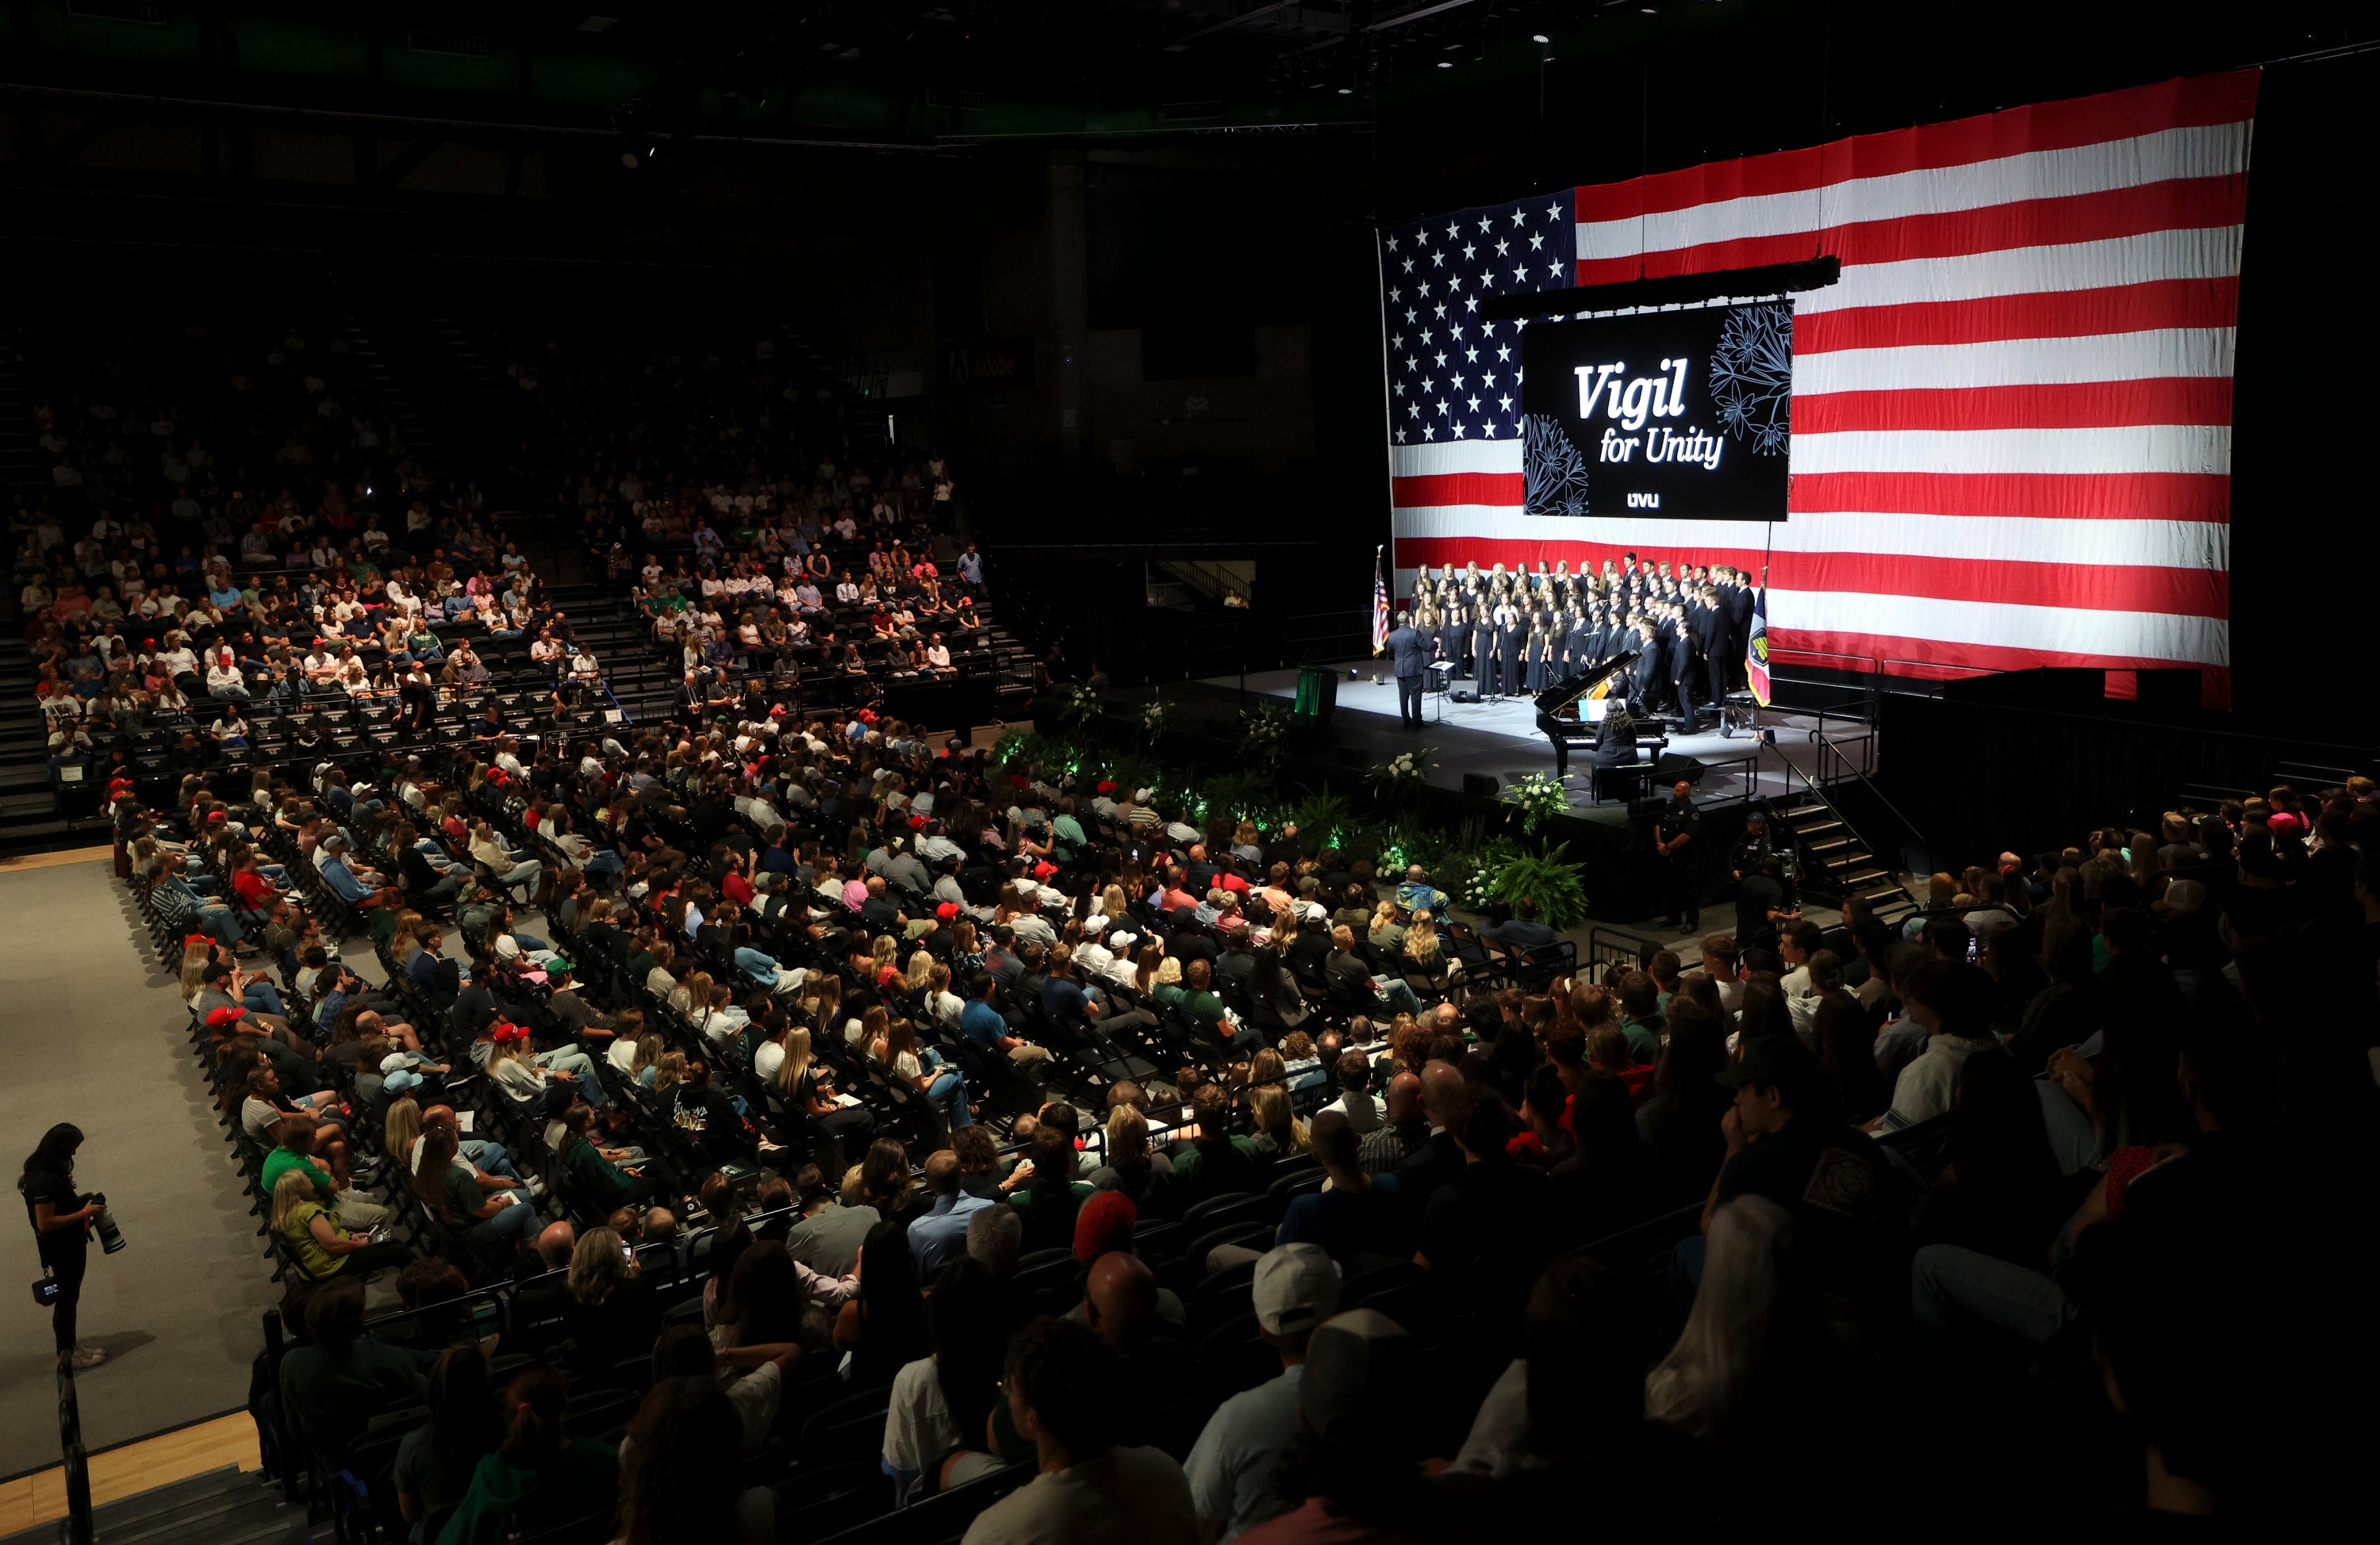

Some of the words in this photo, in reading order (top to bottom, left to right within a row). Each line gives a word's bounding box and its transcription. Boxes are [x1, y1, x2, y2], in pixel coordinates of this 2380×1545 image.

[1573, 358, 1688, 431] Vigil
[1599, 427, 1640, 463] for
[1645, 426, 1724, 470] Unity
[1627, 493, 1660, 508] UVU
